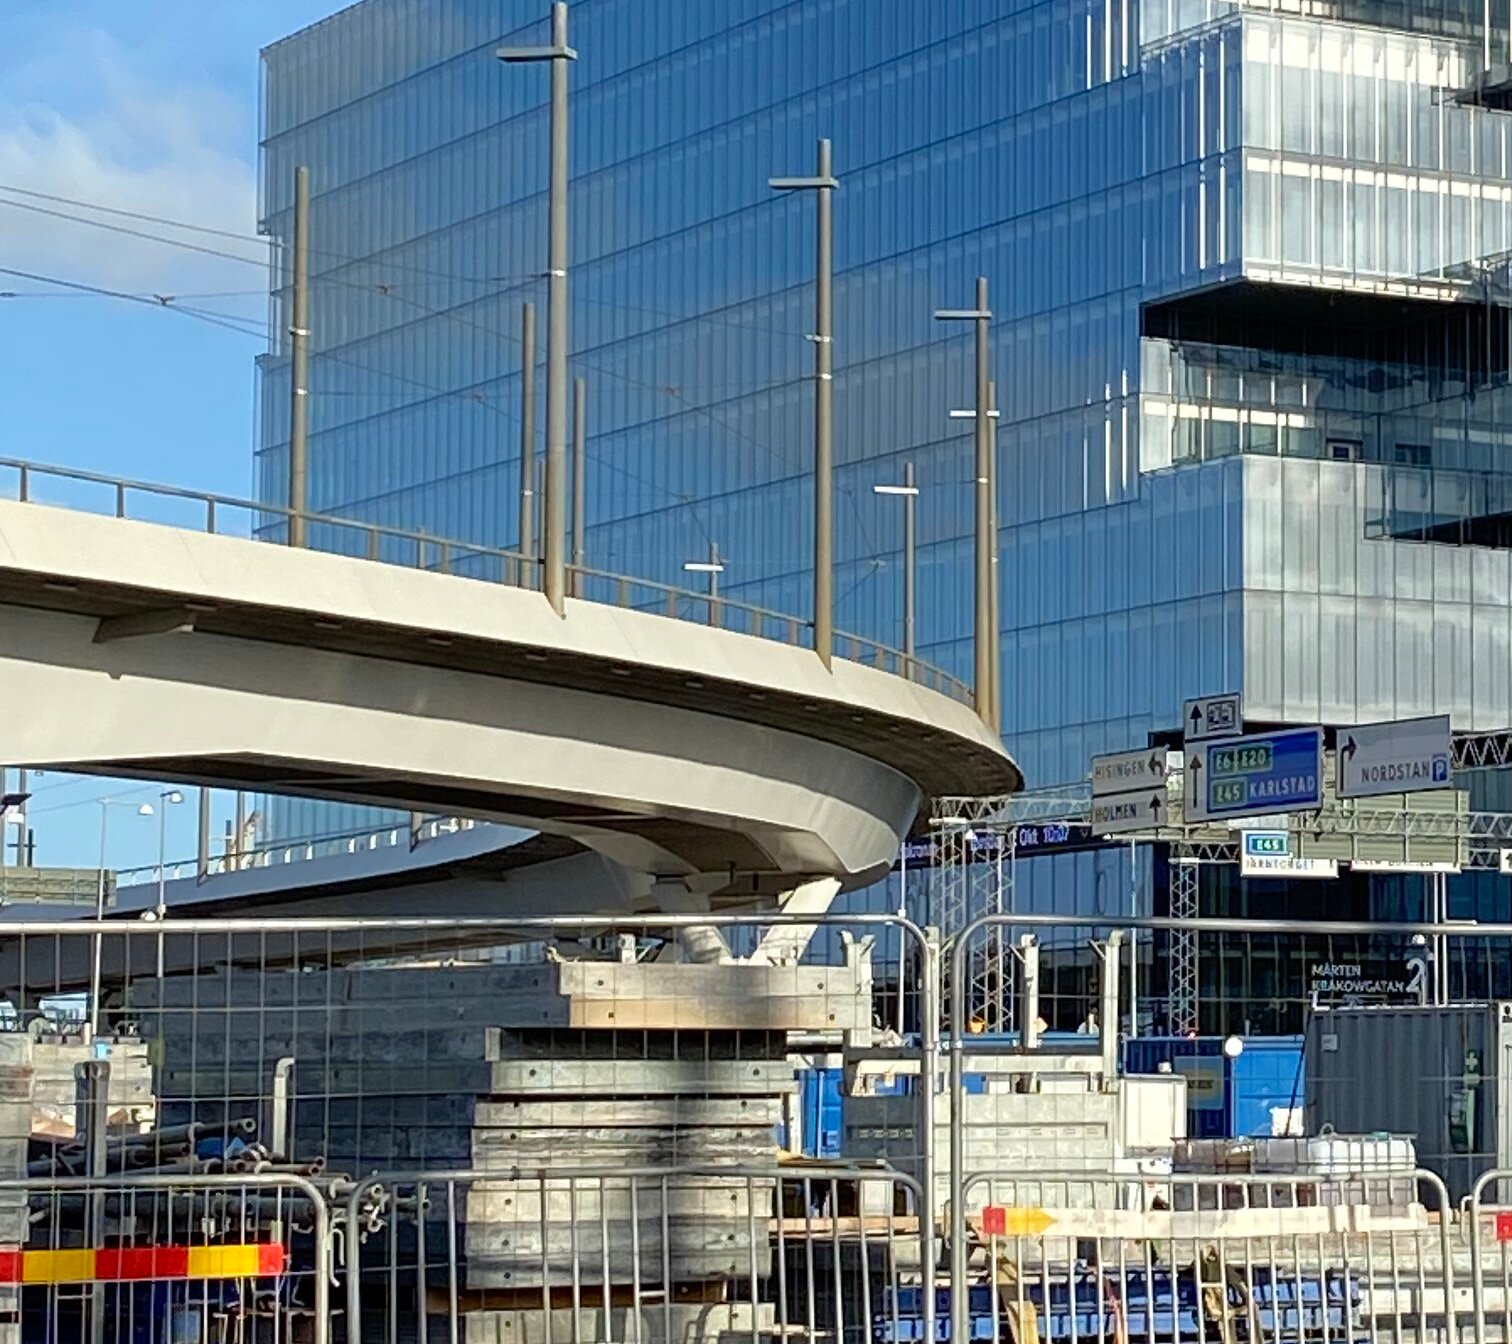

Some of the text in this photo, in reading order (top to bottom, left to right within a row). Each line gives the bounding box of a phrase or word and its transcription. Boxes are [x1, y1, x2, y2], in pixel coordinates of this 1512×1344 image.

[1241, 749, 1267, 767] E20
[1361, 761, 1430, 783] NORDSTAN
[1249, 775, 1315, 798] KARLSTAD
[1256, 839, 1279, 850] E45
[1405, 958, 1426, 993] 2
